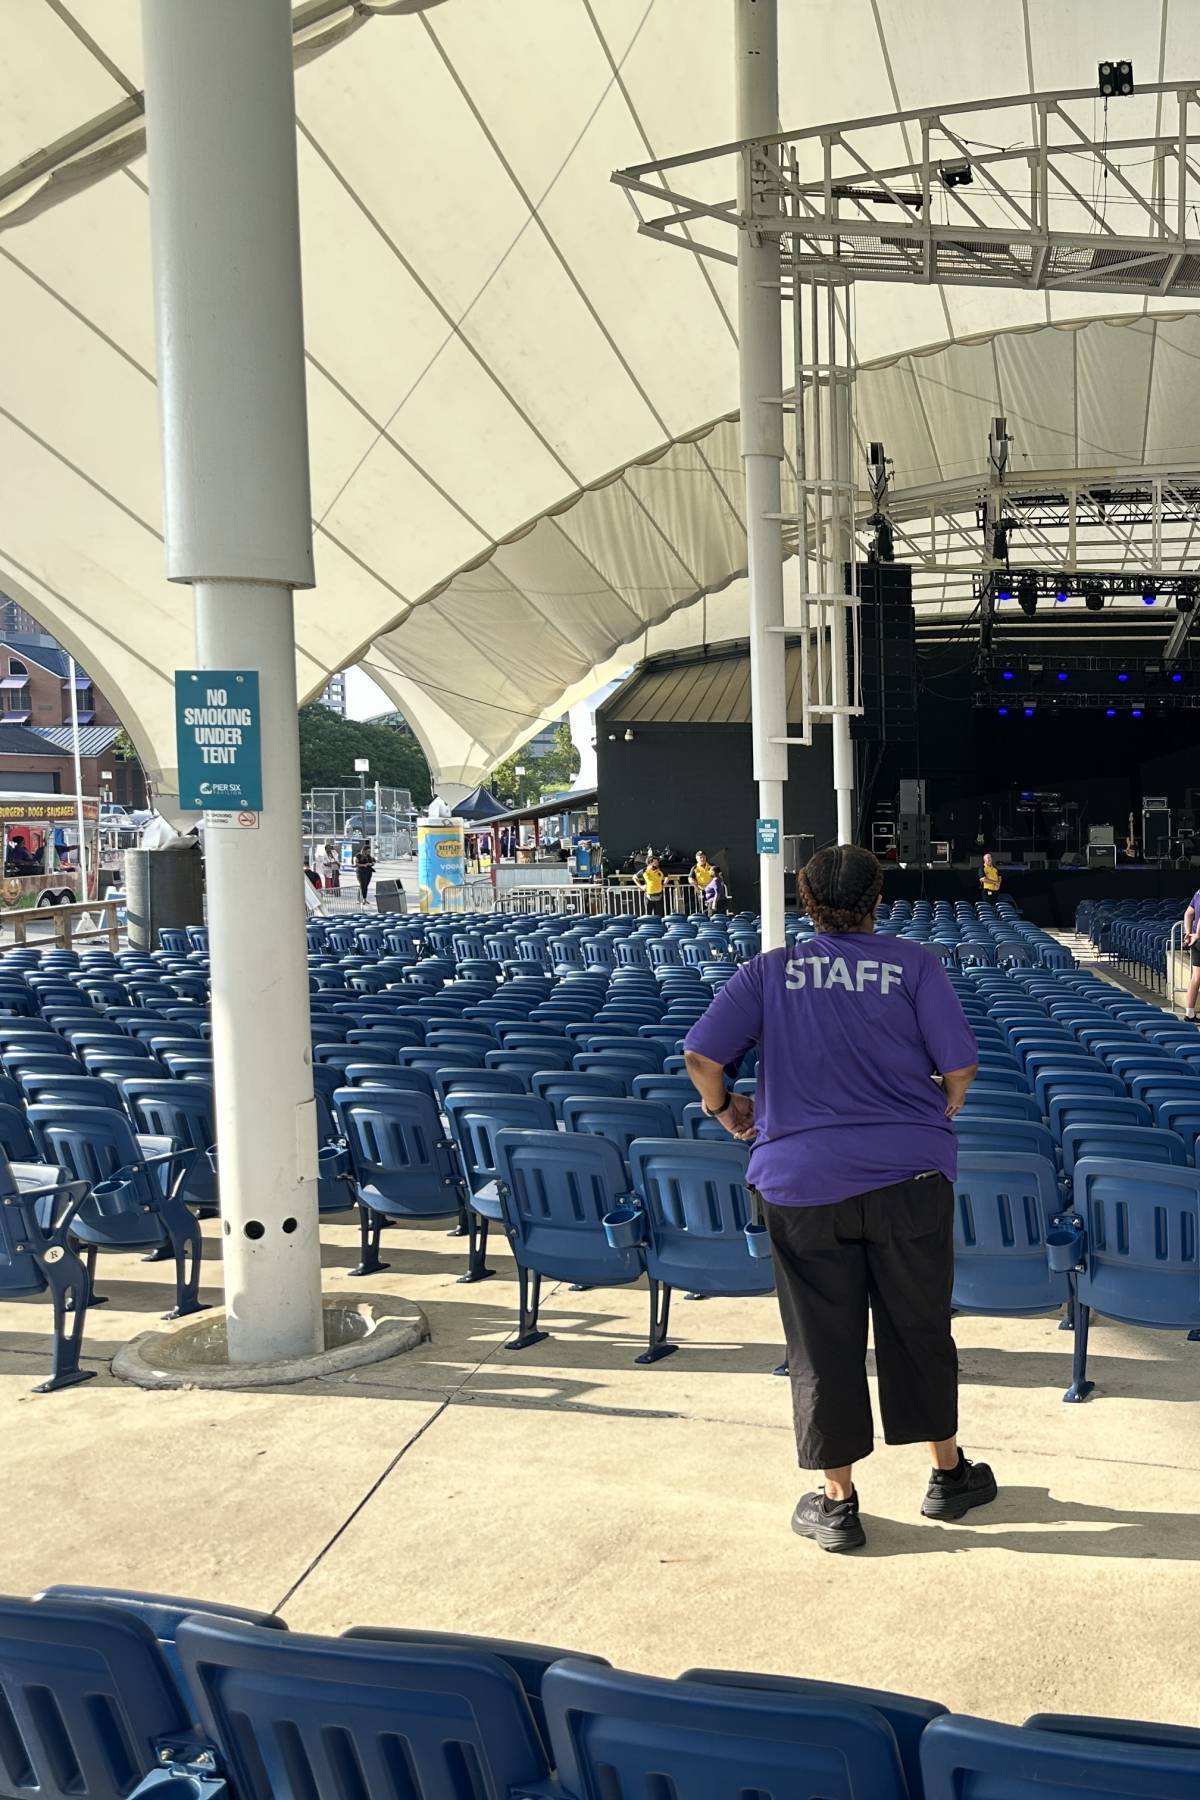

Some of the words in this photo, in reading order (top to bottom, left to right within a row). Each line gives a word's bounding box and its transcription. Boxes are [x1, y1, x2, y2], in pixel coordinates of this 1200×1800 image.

[207, 689, 227, 706] NO
[184, 707, 251, 726] SMOKING
[194, 727, 242, 745] UNDER
[201, 746, 237, 764] TENT
[28, 807, 43, 817] DOGS
[47, 807, 74, 817] SAUSAGES
[785, 956, 903, 995] STAFF
